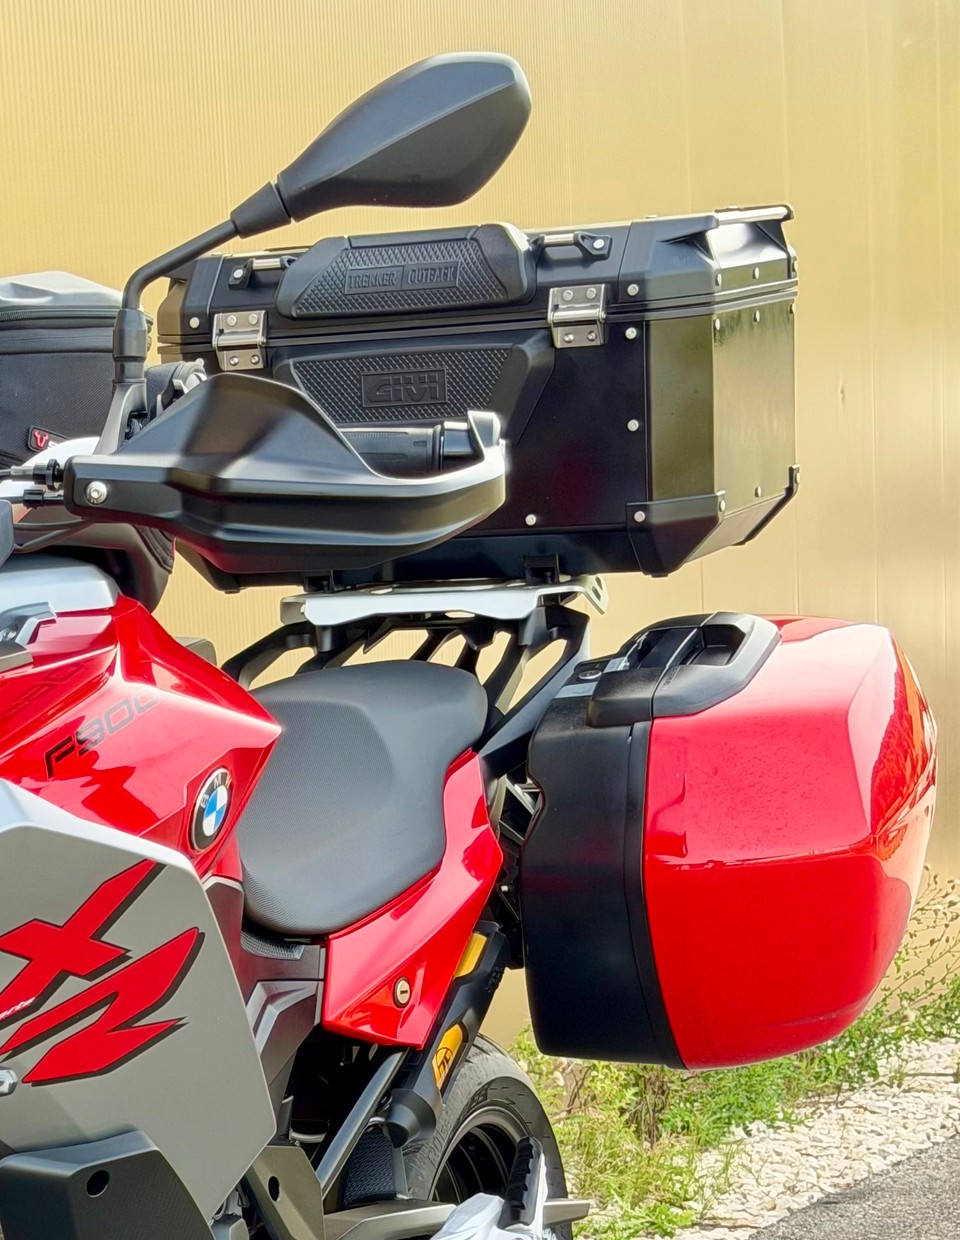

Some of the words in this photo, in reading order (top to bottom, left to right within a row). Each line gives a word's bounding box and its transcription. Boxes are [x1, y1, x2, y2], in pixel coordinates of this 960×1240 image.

[348, 271, 397, 290] TREKKER
[407, 265, 455, 285] OUTBACK
[366, 373, 440, 403] GIVI
